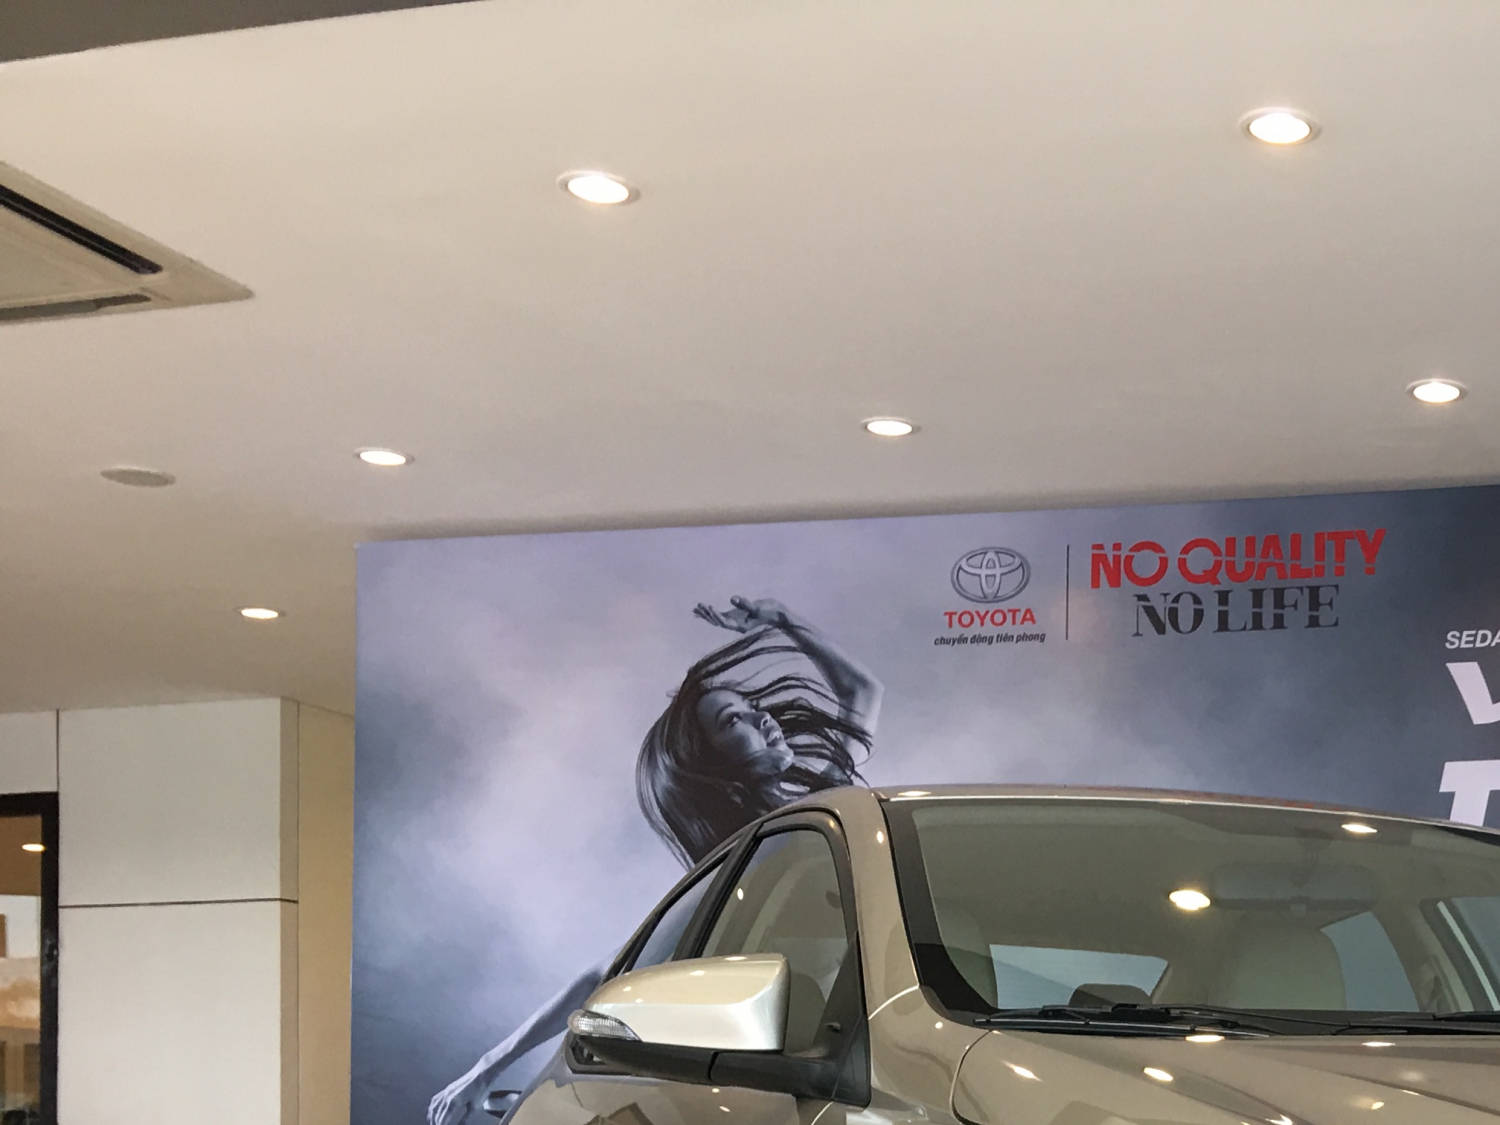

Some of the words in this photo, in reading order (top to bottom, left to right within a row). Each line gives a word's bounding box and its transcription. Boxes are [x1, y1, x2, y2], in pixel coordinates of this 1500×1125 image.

[1091, 540, 1168, 589] NO
[1177, 528, 1387, 586] QUALITY
[943, 607, 1036, 629] TOYOTA
[1132, 590, 1205, 637] NO
[1212, 584, 1340, 633] LIFE
[1015, 632, 1046, 644] phong
